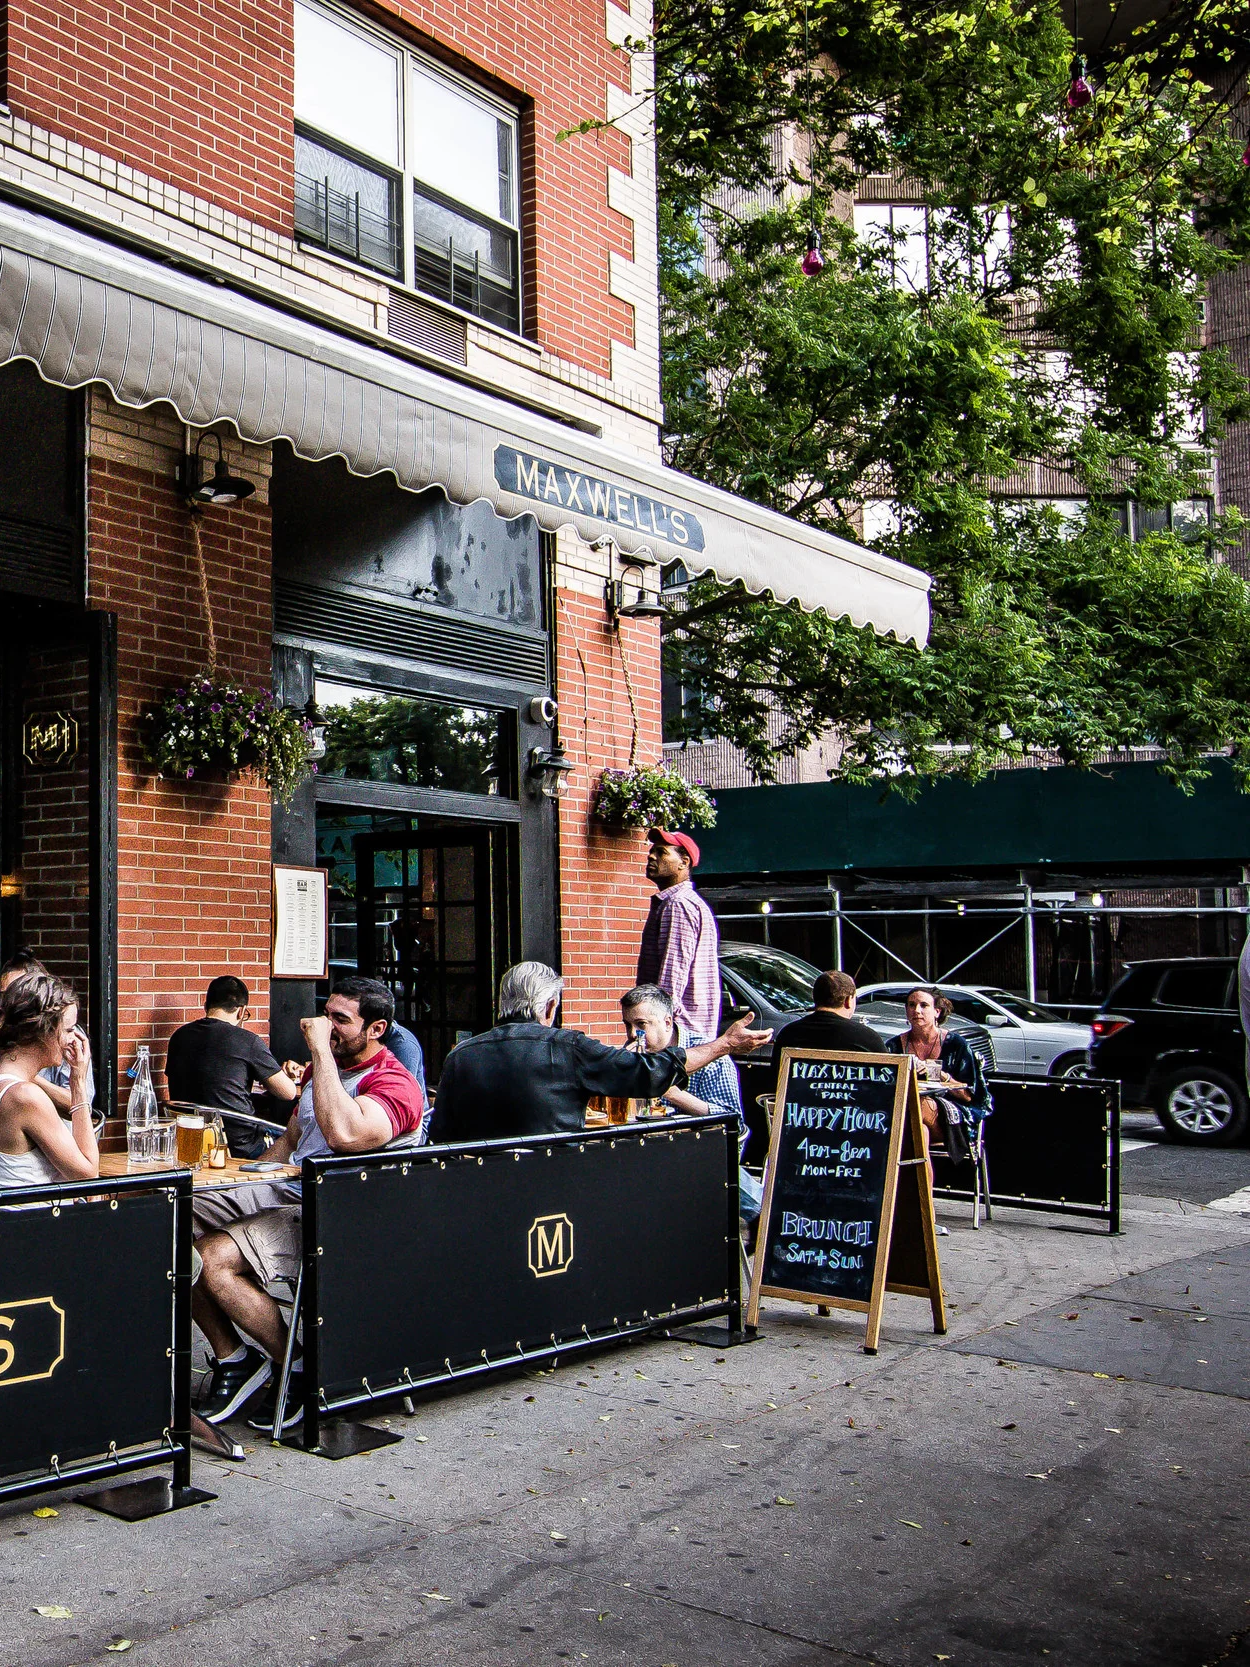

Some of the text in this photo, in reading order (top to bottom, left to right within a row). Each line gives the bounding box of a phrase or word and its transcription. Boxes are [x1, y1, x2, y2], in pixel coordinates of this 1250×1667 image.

[515, 453, 689, 545] MAXWELL'S
[809, 1082, 858, 1091] CENTRAL
[821, 1091, 856, 1101] PARK
[785, 1102, 888, 1134] HAPPY HOUR
[536, 1221, 564, 1269] M
[780, 1211, 873, 1247] BRUNCH
